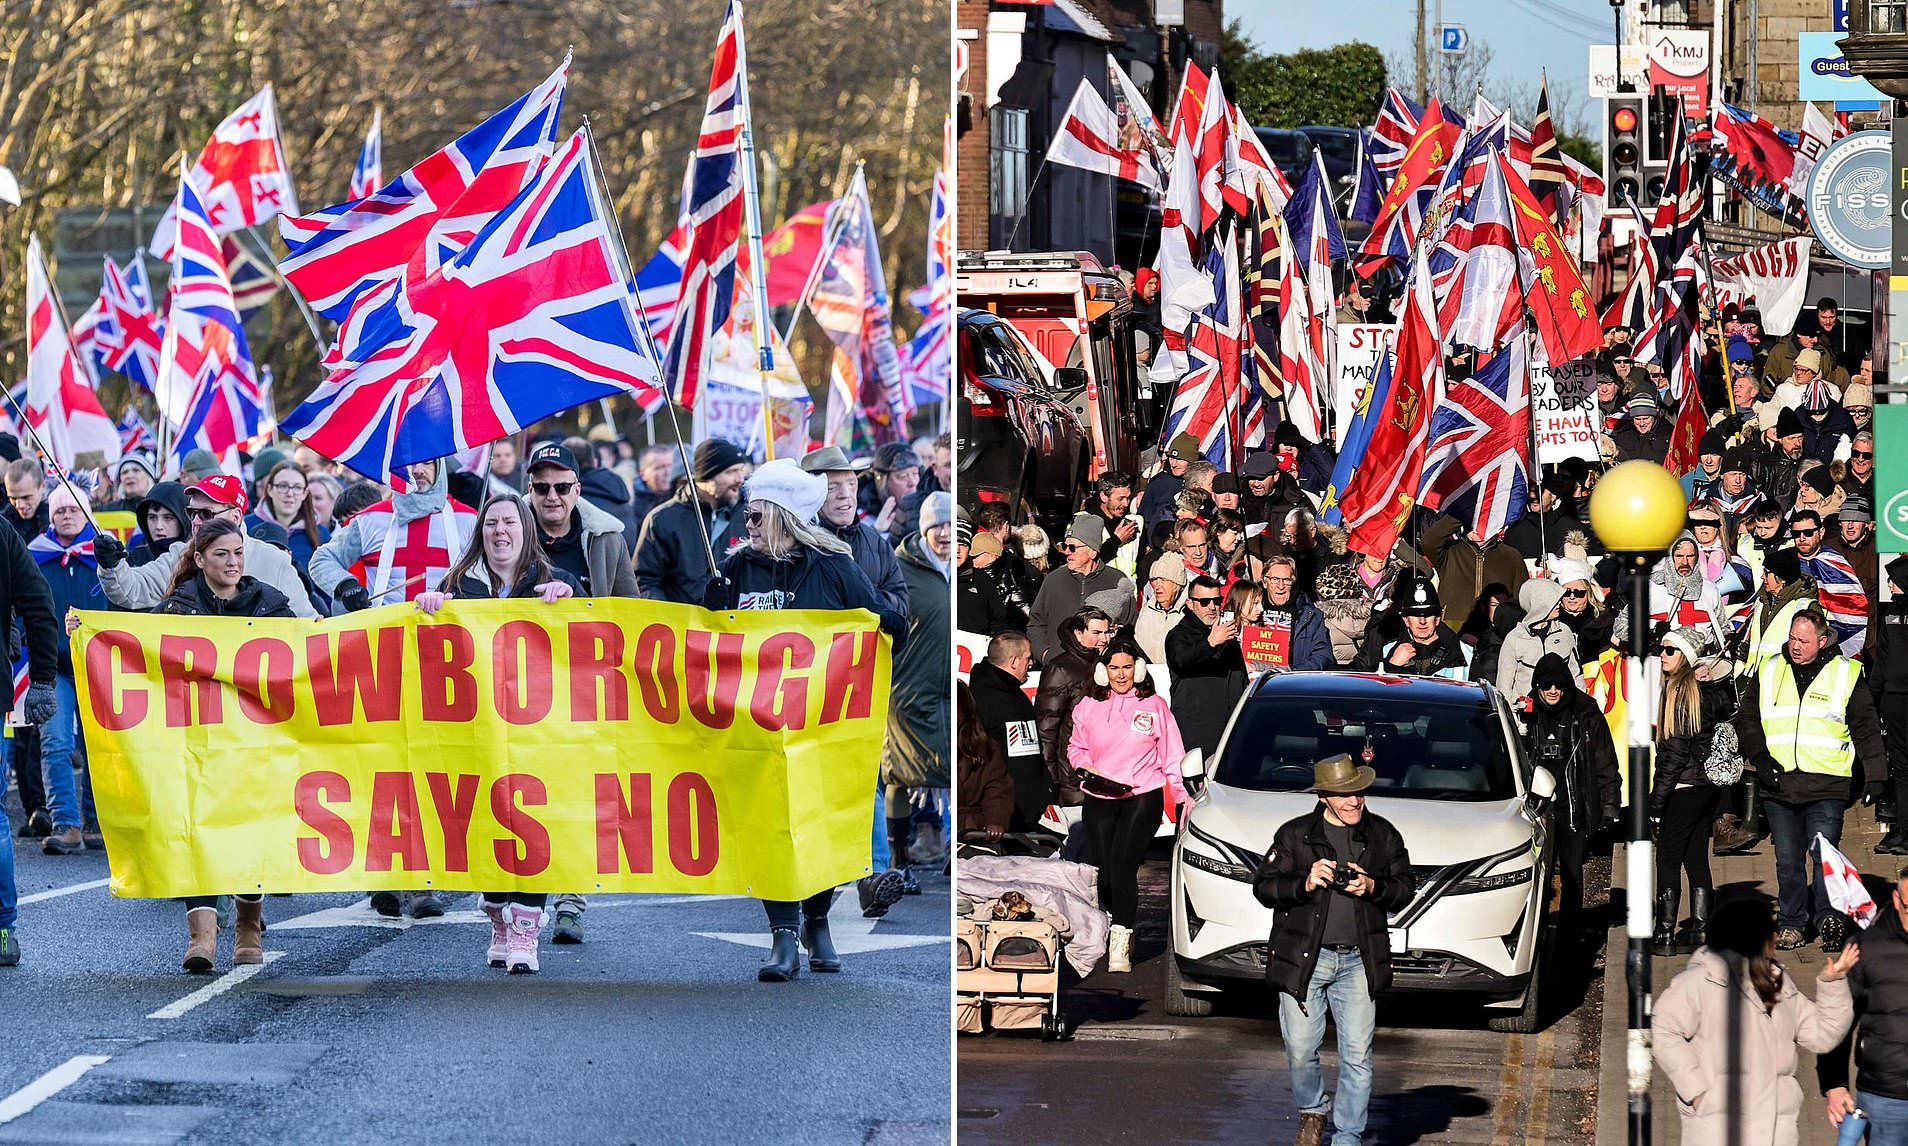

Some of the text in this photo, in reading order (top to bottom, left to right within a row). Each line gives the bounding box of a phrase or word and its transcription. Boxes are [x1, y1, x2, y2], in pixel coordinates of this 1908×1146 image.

[1446, 31, 1456, 47] P
[1673, 46, 1704, 59] KMJ
[1678, 84, 1697, 92] Local
[1815, 192, 1890, 210] FISS
[1531, 363, 1593, 380] TRAYED
[1554, 380, 1589, 396] OUR
[1535, 415, 1593, 431] E HAVE
[1568, 431, 1599, 443] TOO
[758, 594, 784, 606] RAIE
[1259, 630, 1273, 639] MY
[1250, 640, 1280, 651] SAFETY
[1246, 651, 1283, 663] MATTERS
[85, 619, 879, 731] CROWBOROUGH
[293, 770, 720, 877] SAYS NO
